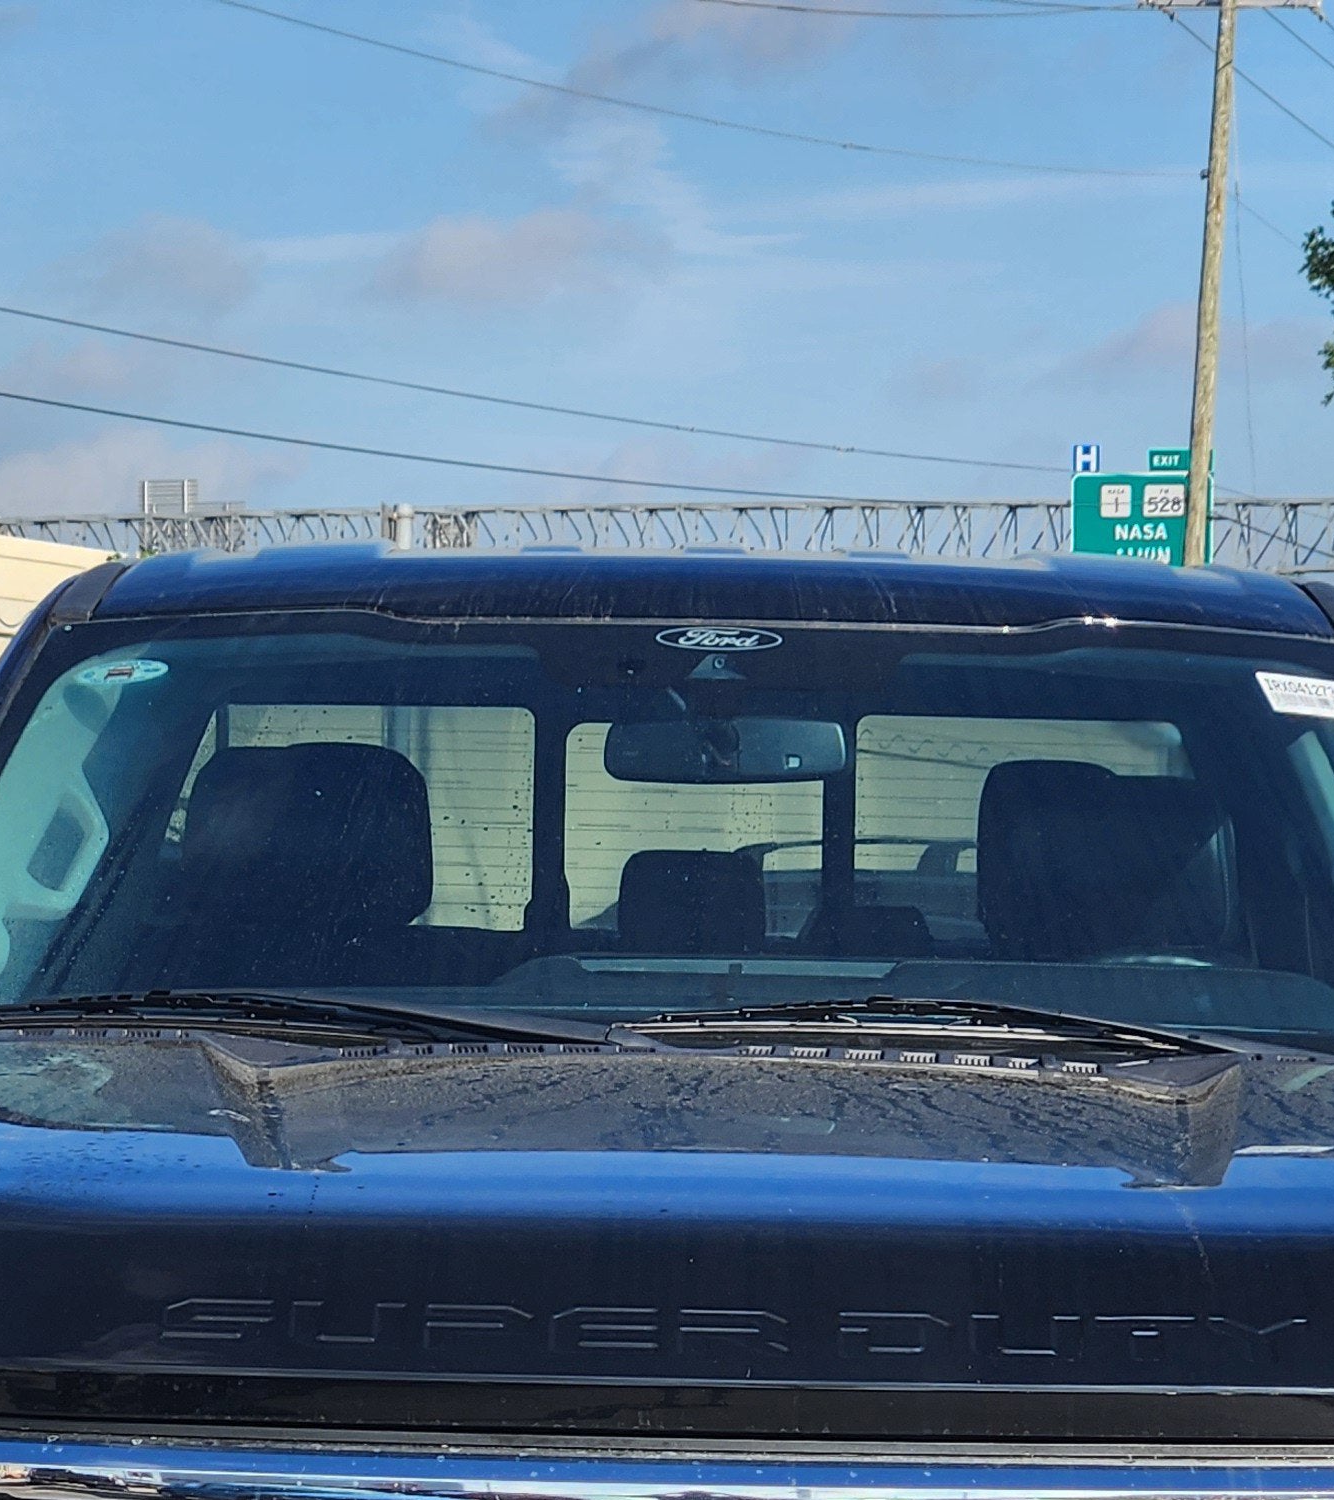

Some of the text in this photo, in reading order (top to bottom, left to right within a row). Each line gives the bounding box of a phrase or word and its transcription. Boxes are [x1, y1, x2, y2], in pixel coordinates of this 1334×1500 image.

[1152, 454, 1181, 467] EXIT
[1147, 496, 1183, 513] 528
[1114, 522, 1169, 541] NASA
[677, 629, 760, 647] Ford
[161, 1298, 1308, 1363] SUPER DUTY
